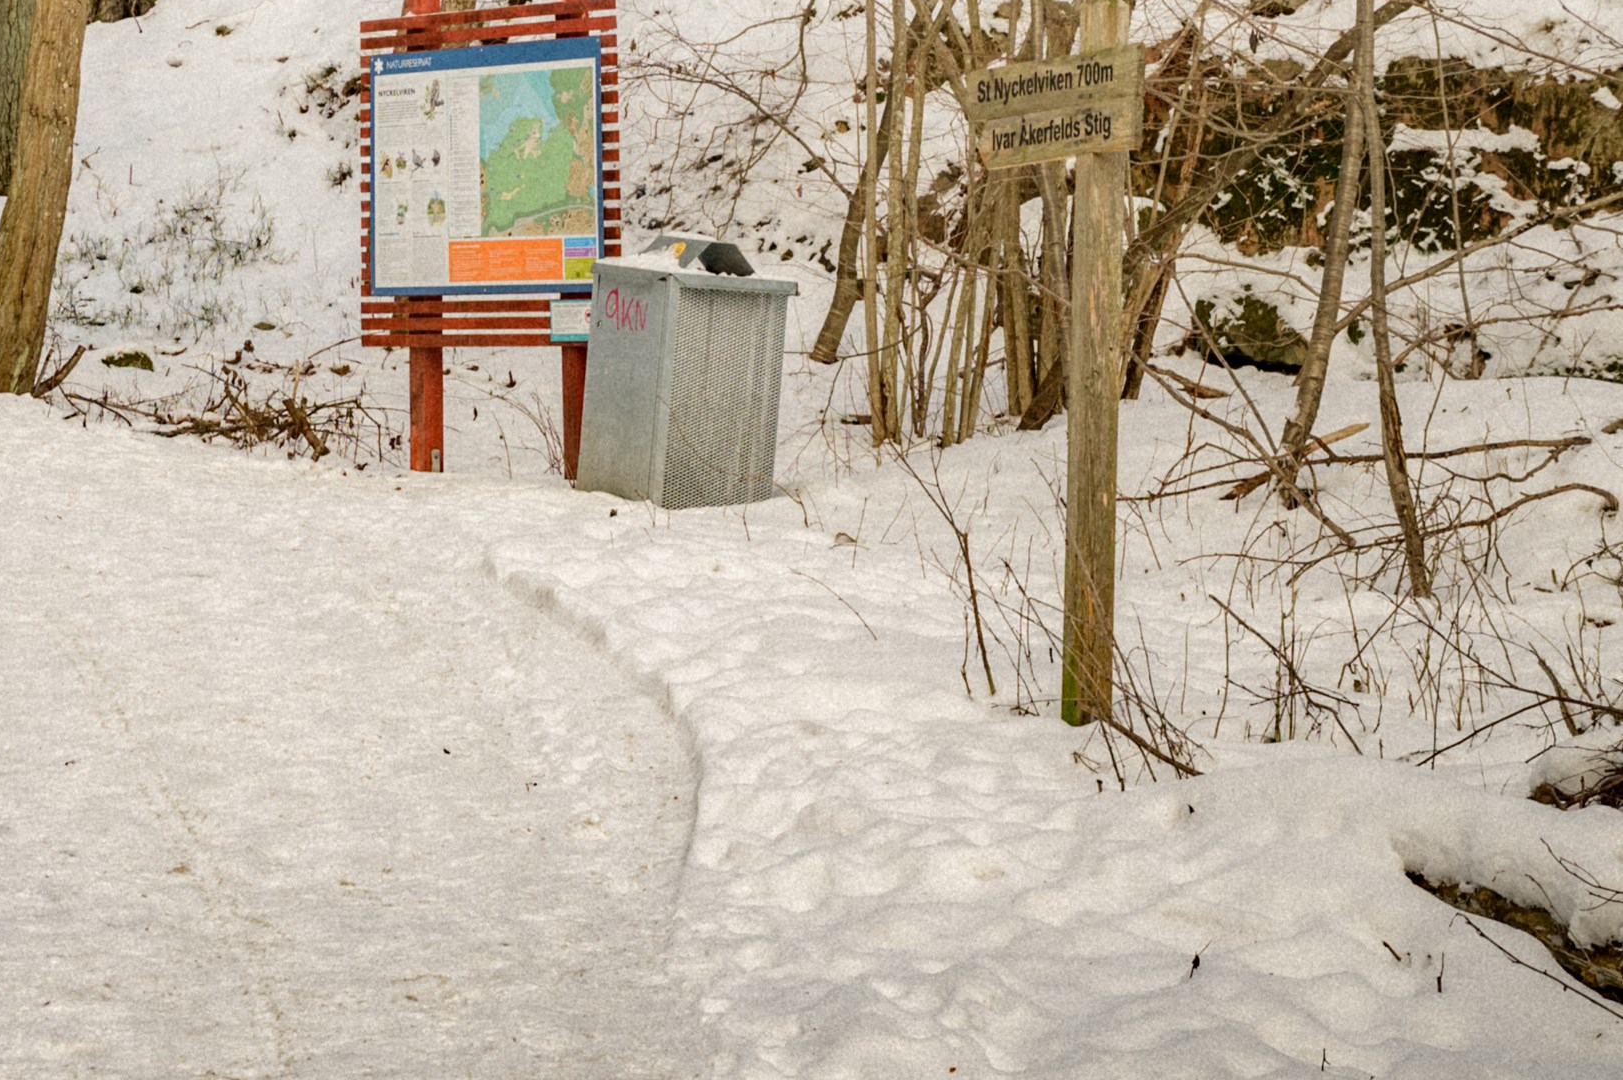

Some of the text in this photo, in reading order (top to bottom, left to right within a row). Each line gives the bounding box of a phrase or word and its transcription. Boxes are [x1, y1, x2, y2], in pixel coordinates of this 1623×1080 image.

[386, 57, 432, 69] NATURRESERVAT
[378, 88, 416, 97] NYCKELVIKEN
[977, 61, 1114, 105] St Nyckelviken 700m
[992, 111, 1112, 151] Ivar Åkerfelds Stig
